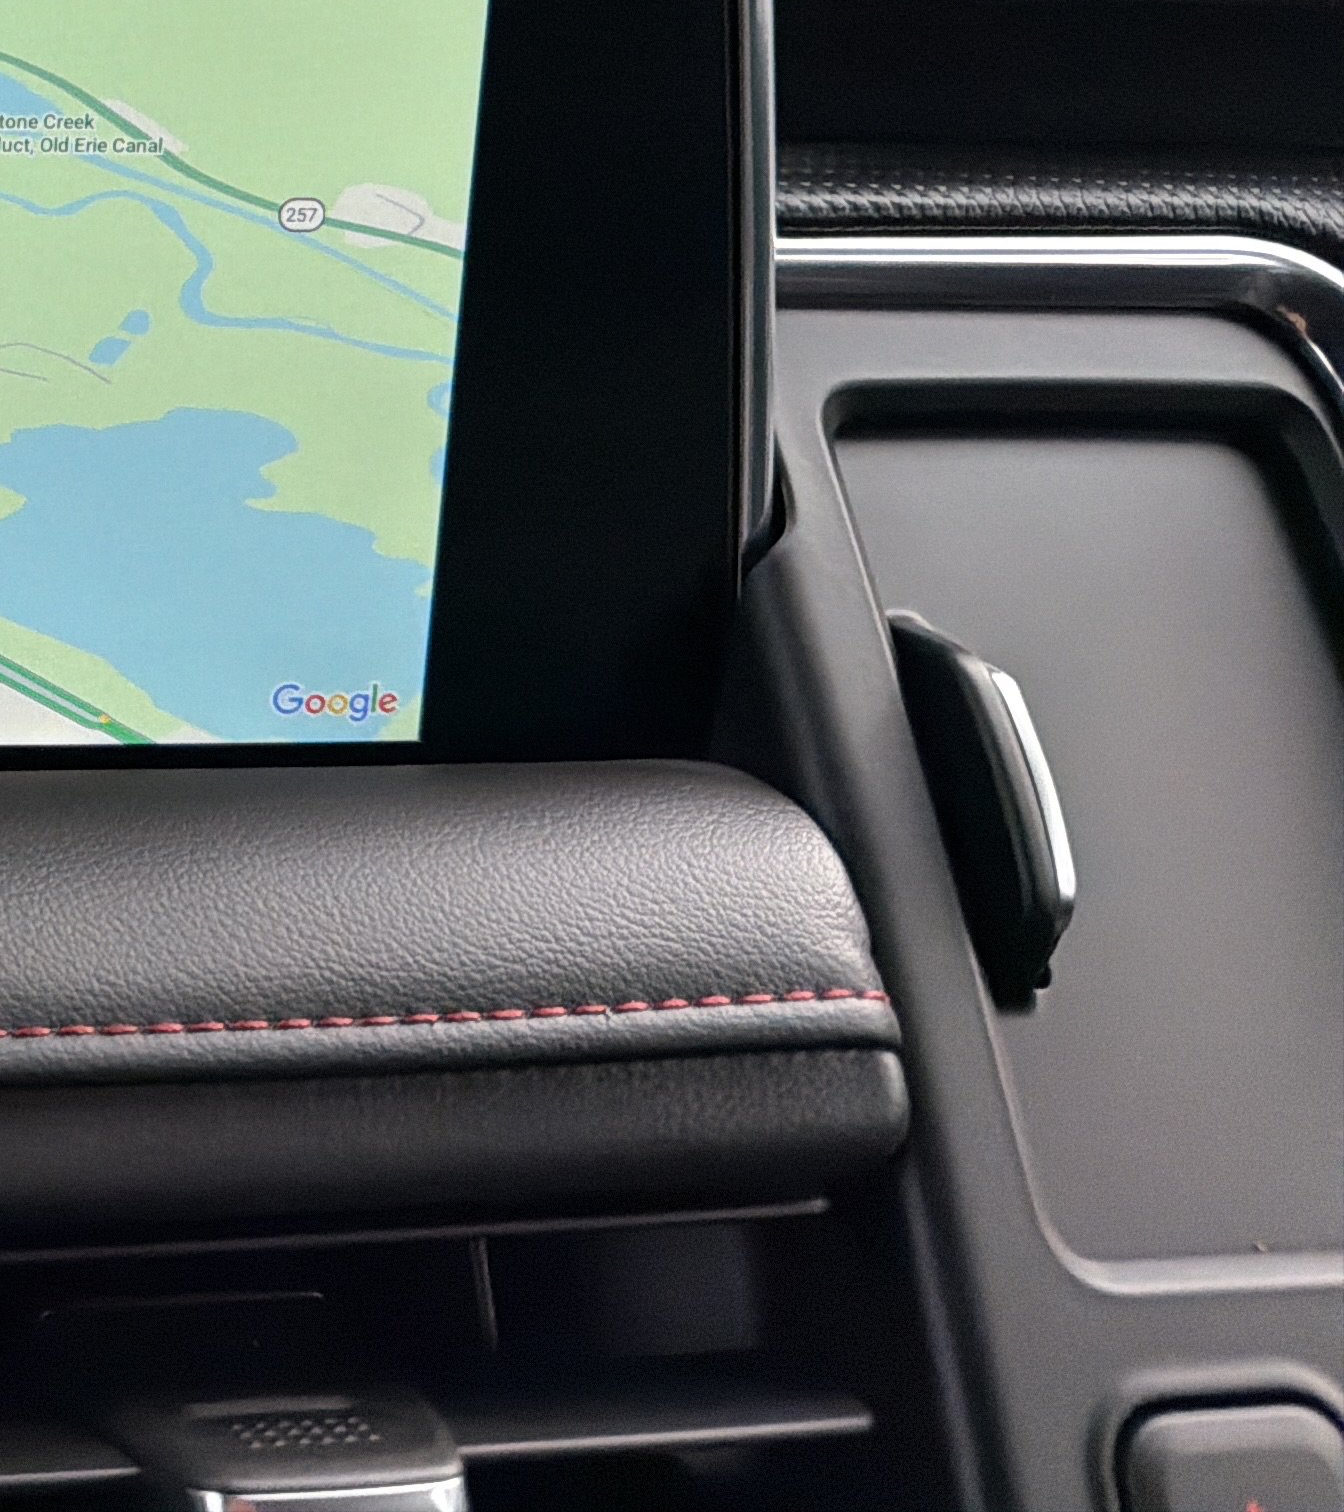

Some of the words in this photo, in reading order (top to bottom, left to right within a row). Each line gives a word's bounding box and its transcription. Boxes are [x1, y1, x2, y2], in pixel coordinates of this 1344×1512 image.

[43, 113, 95, 130] Creek
[40, 137, 69, 154] Old
[74, 137, 108, 154] Erie
[111, 137, 163, 154] Canal
[285, 207, 318, 224] 257
[272, 683, 399, 722] Google
